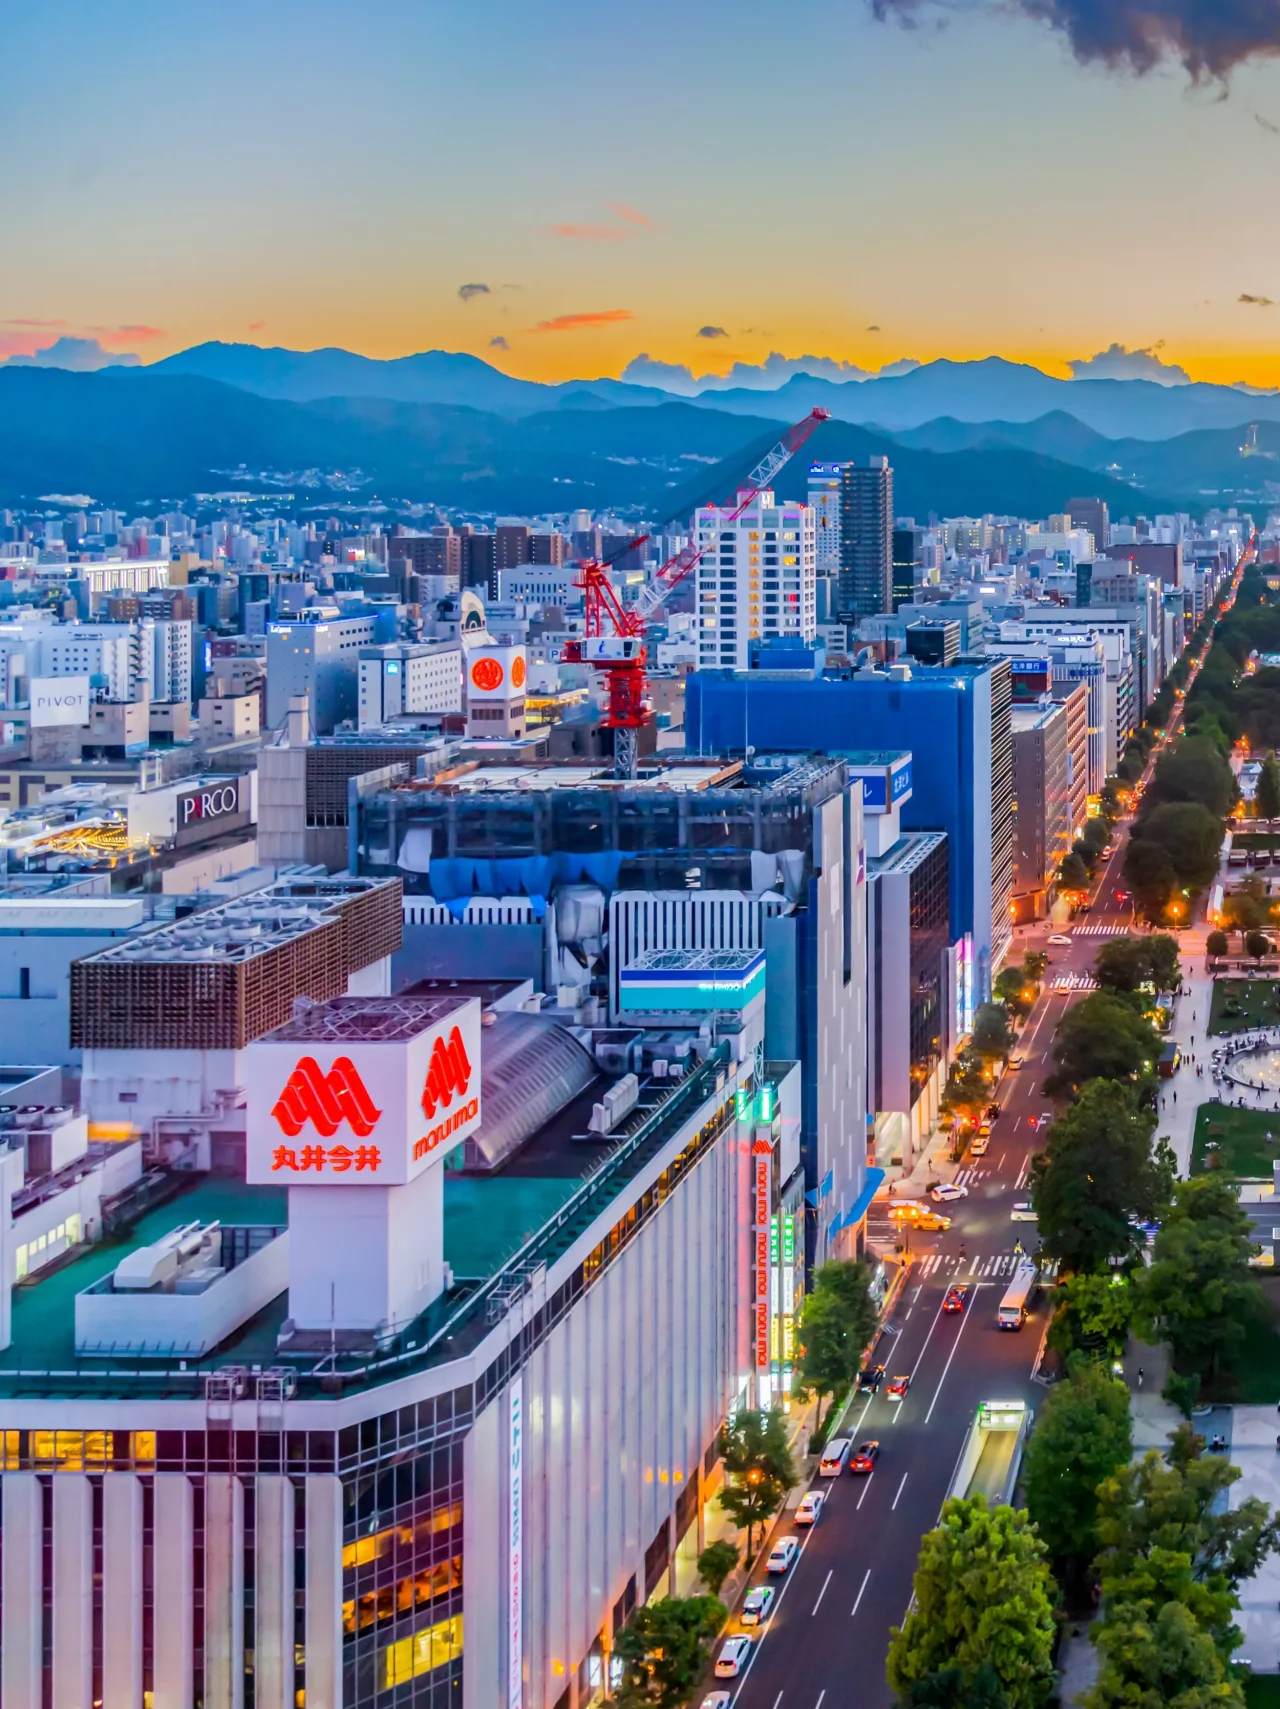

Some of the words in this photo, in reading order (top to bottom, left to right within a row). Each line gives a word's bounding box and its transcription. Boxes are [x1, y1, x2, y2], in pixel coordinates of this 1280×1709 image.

[38, 695, 84, 707] PIVOT
[184, 786, 237, 824] PARCO
[271, 1145, 382, 1172] 丸井今井
